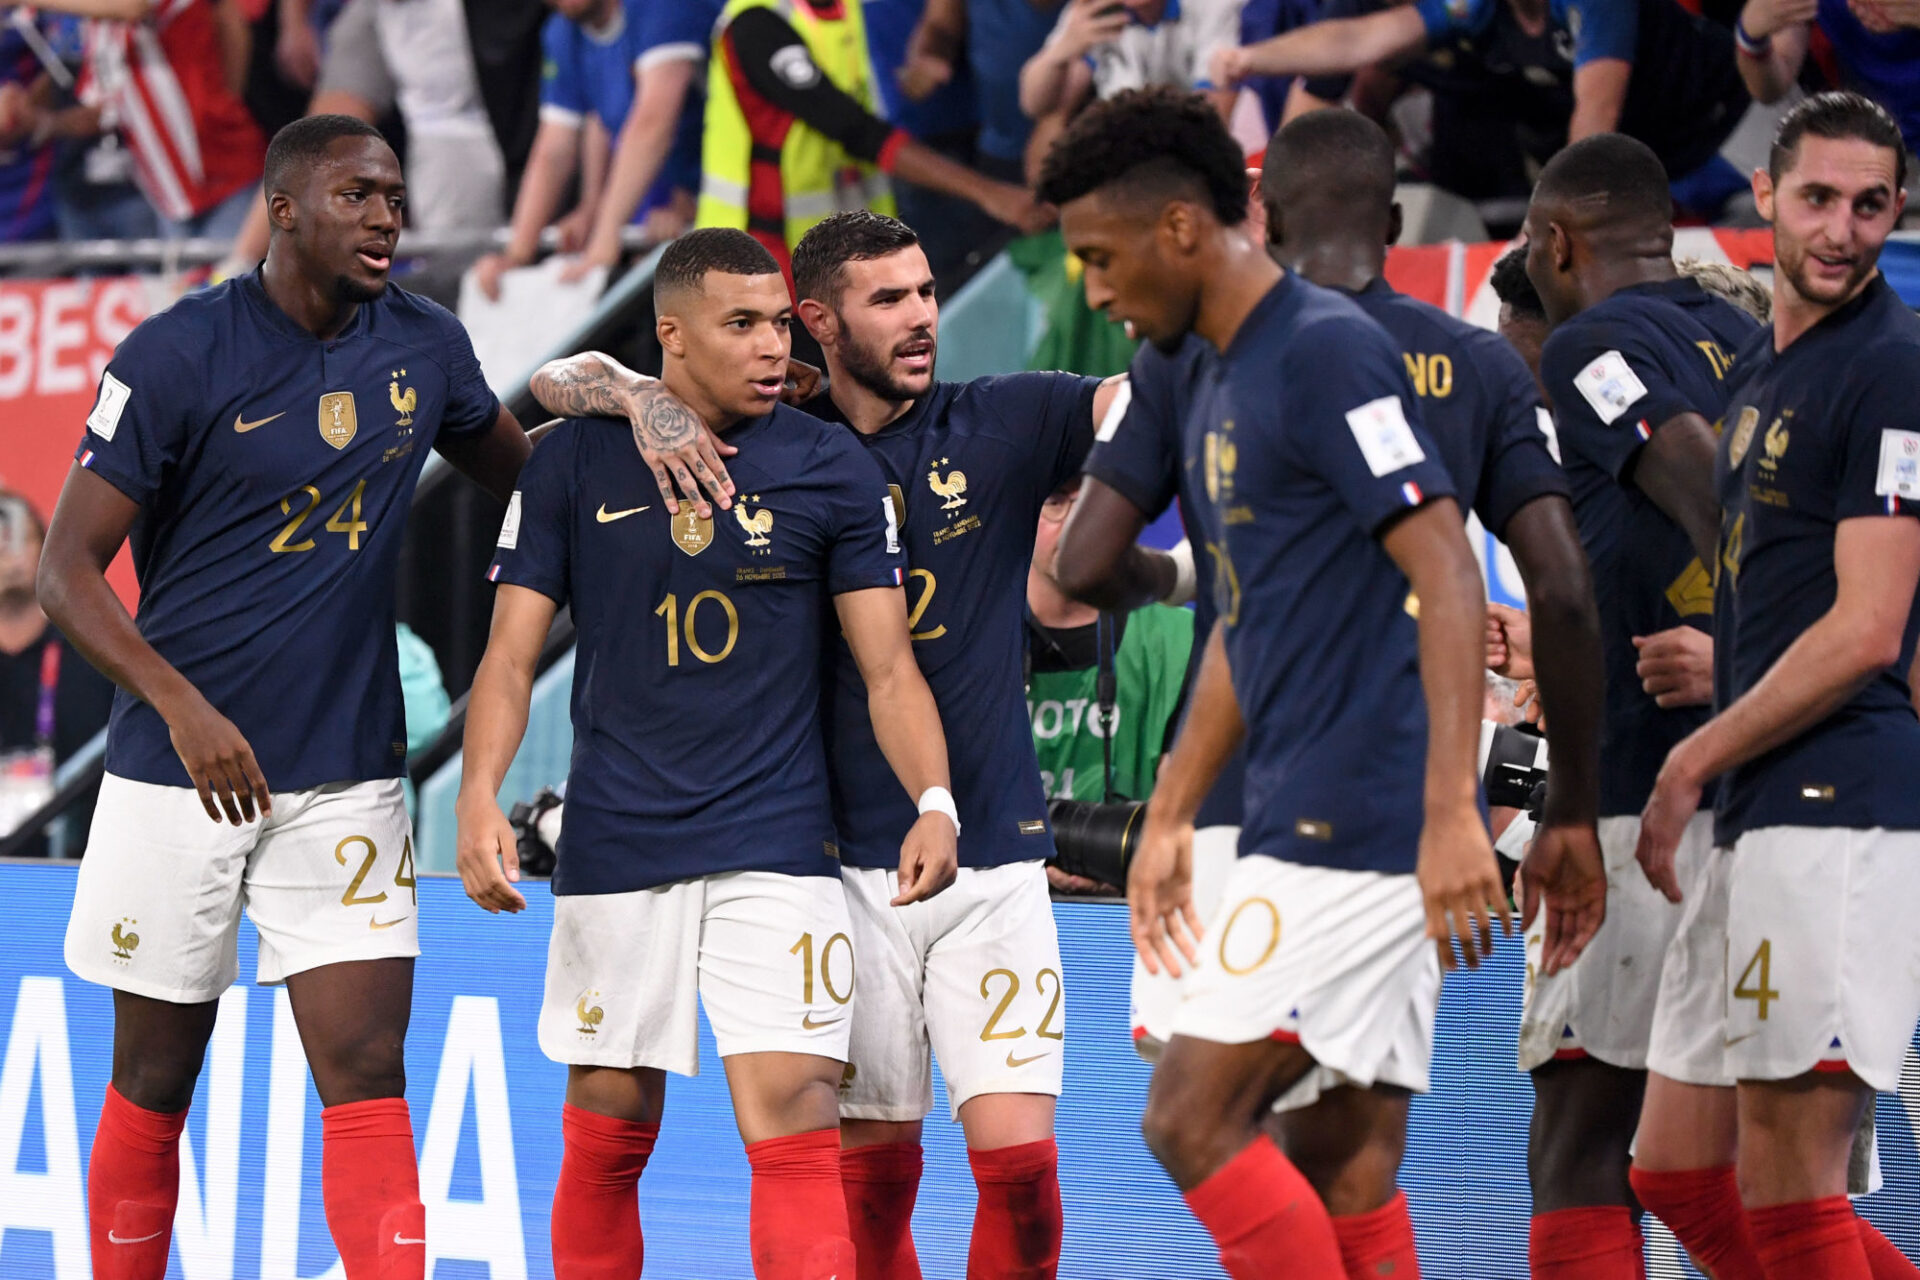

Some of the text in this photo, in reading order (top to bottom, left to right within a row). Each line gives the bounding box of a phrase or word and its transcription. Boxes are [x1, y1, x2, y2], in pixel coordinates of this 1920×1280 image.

[330, 427, 348, 435] FIFA
[268, 478, 367, 553] 24
[683, 533, 702, 541] FIFA
[654, 589, 739, 666] 10
[908, 568, 948, 641] 2
[335, 834, 417, 906] 24
[789, 932, 855, 1005] 10
[980, 968, 1063, 1041] 22
[1725, 935, 1780, 1020] 4
